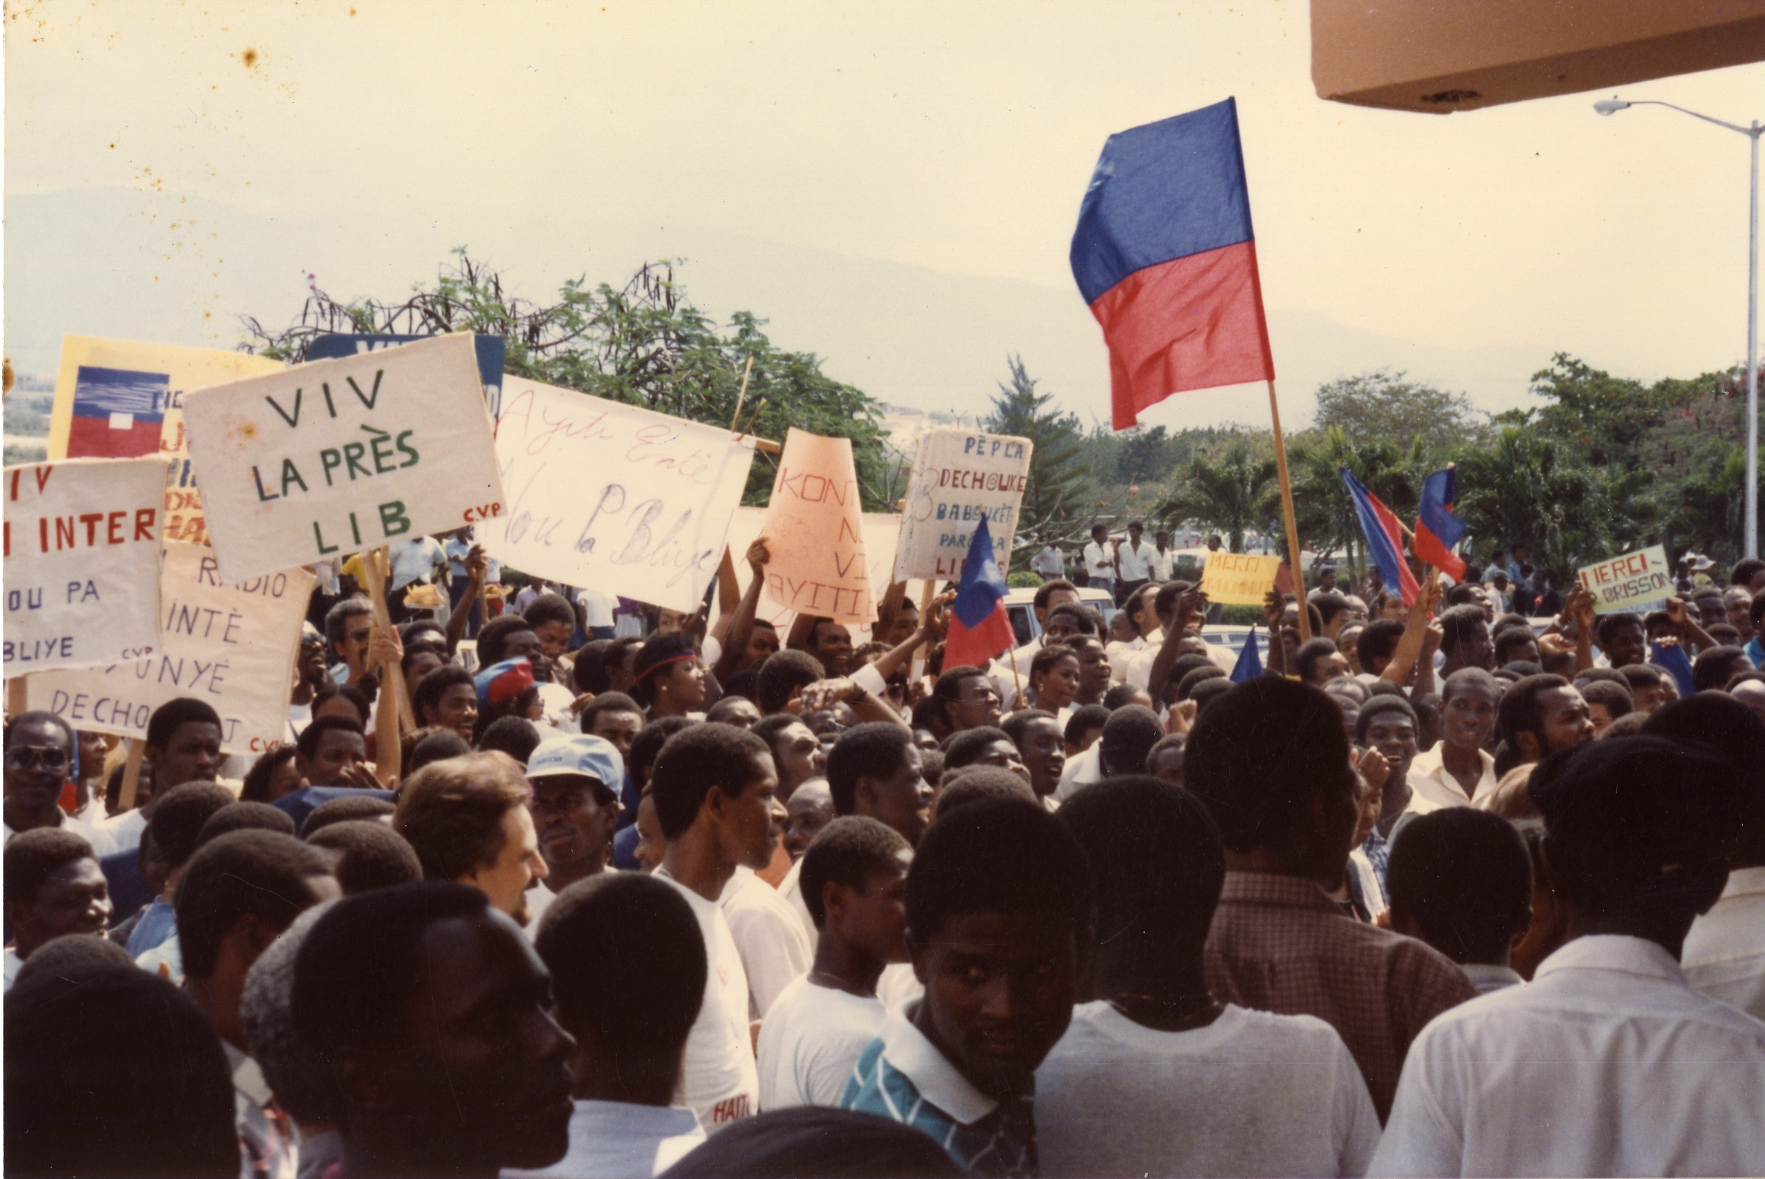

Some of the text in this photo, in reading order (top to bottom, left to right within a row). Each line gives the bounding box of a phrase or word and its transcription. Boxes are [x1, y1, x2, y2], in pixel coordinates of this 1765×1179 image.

[265, 369, 384, 428] VIV
[39, 508, 156, 553] INTER
[313, 500, 411, 555] LIB
[67, 580, 100, 603] PA
